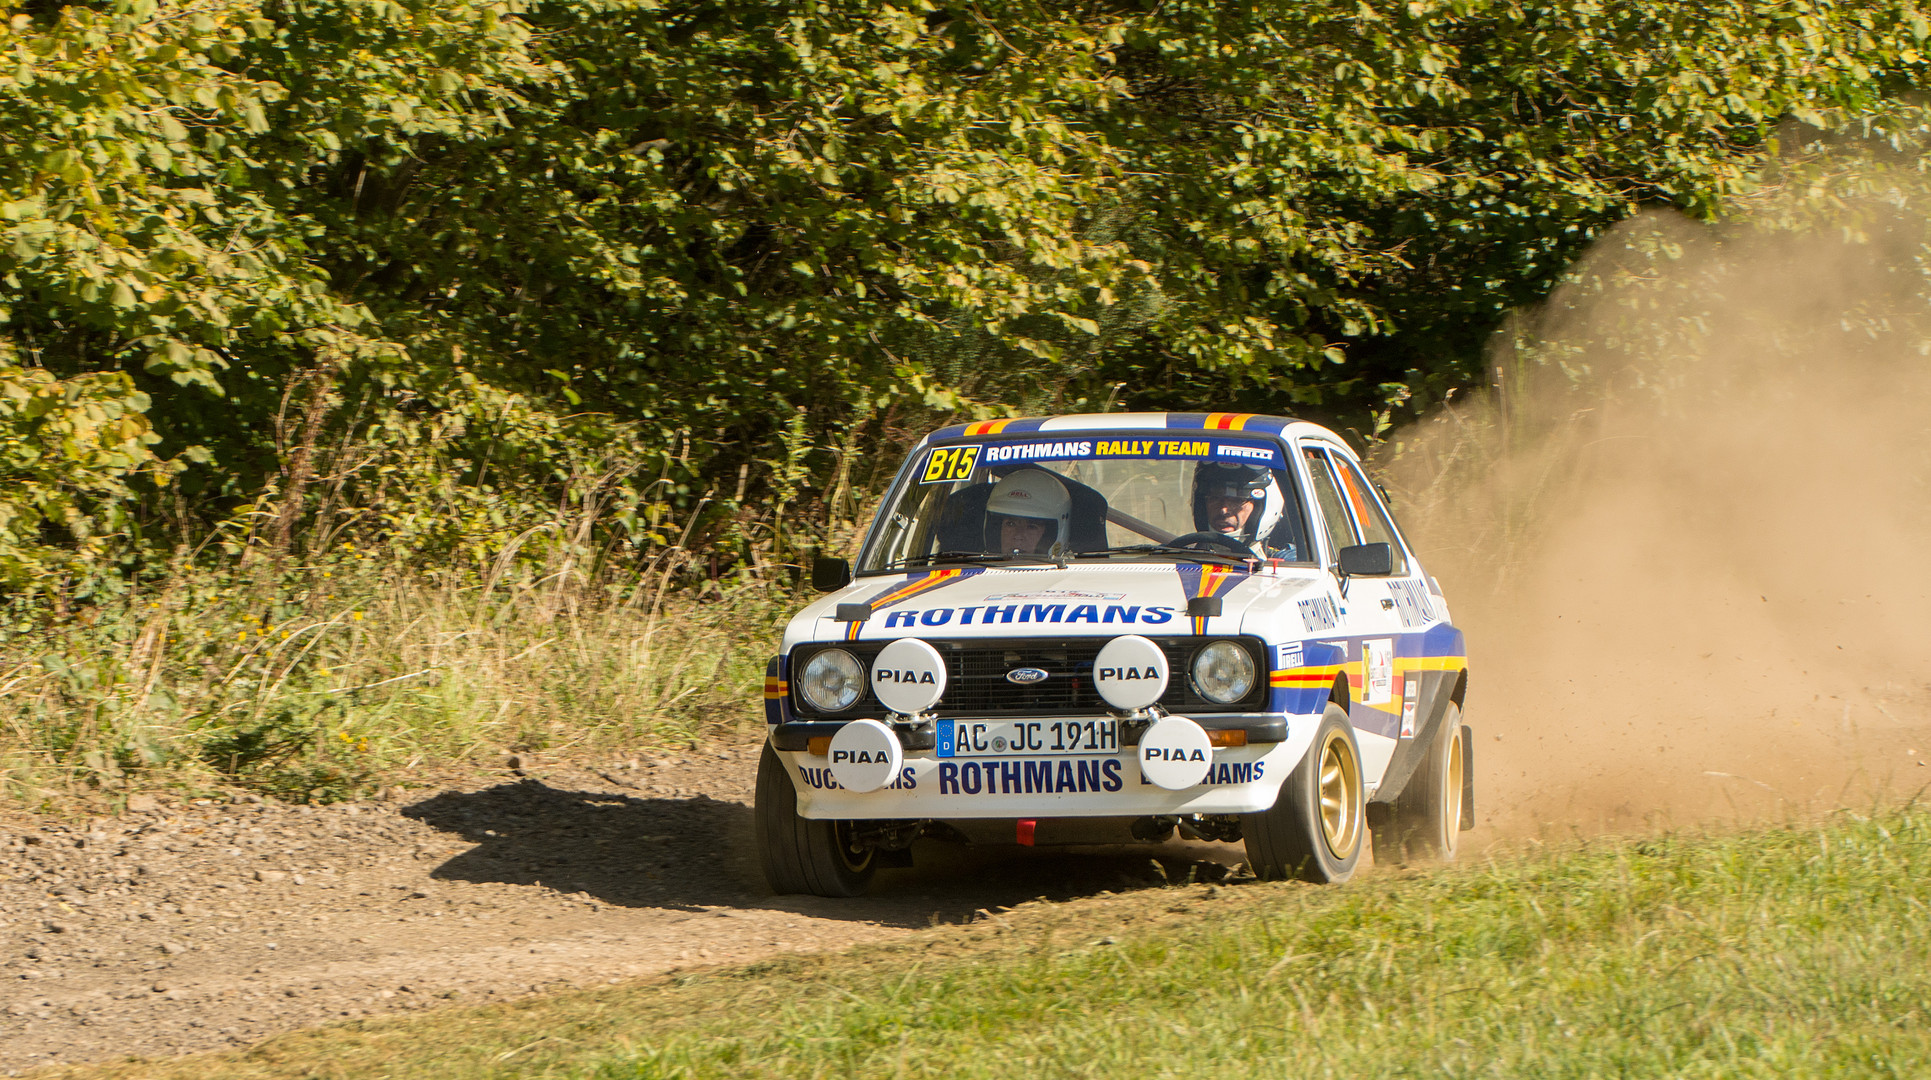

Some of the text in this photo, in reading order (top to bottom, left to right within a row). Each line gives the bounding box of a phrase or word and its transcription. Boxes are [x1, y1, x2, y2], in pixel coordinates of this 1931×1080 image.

[986, 440, 1210, 462] ROTHMANS RALLY TEAM
[1217, 444, 1274, 460] PIRELLI
[924, 447, 977, 482] B15
[884, 604, 1175, 629] ROTHMANS
[1278, 640, 1304, 670] PIRELLI
[876, 669, 936, 685] PIAA
[1015, 670, 1038, 681] Ford
[1099, 666, 1160, 681] PIAA
[956, 720, 1117, 751] AC JC 191H
[943, 741, 950, 751] D
[833, 750, 889, 764] PIAA
[1145, 748, 1205, 762] PIAA
[939, 758, 1123, 794] ROTHMANS
